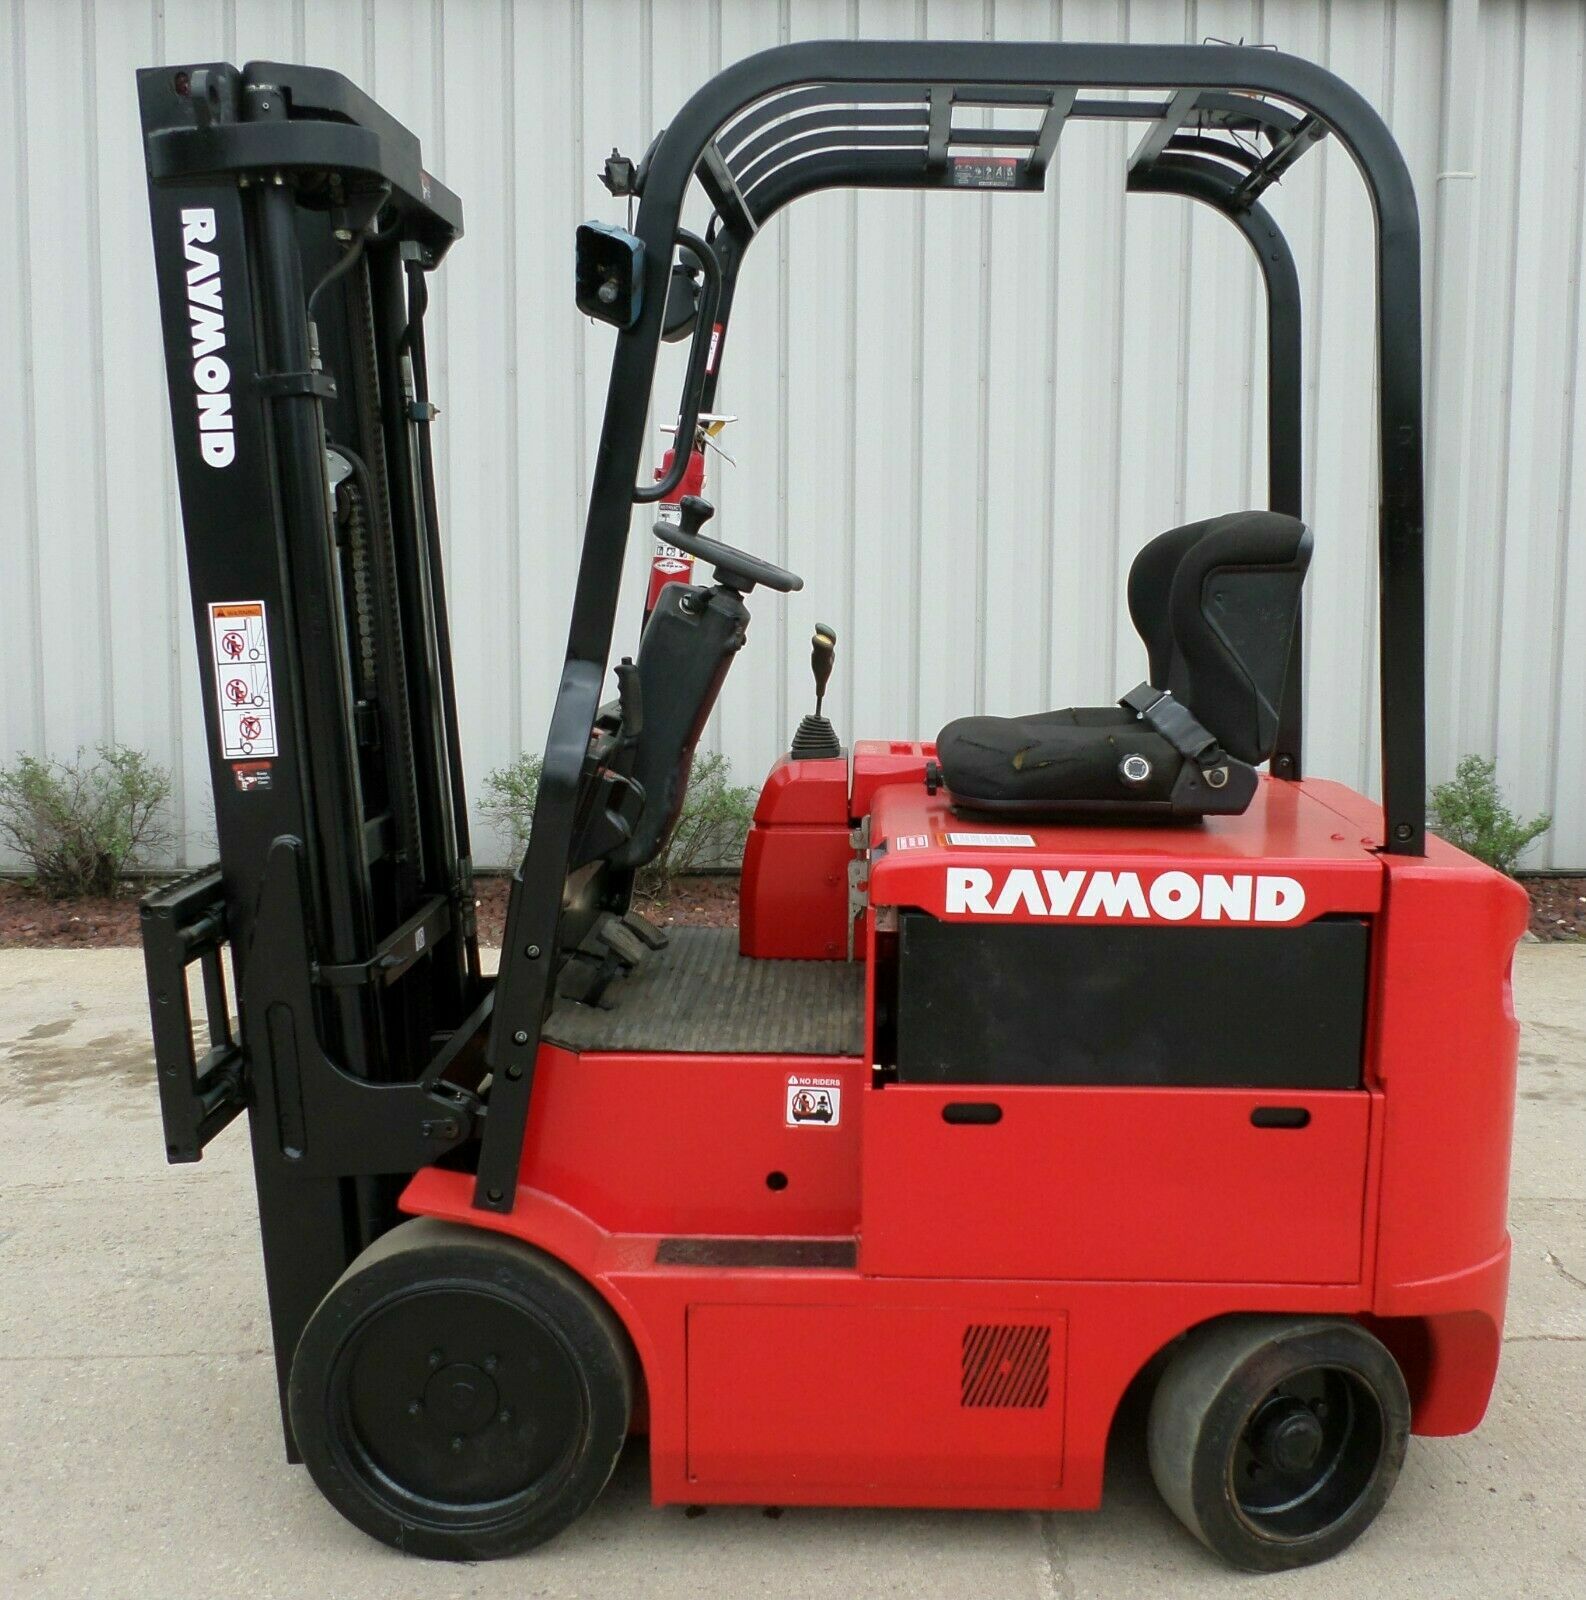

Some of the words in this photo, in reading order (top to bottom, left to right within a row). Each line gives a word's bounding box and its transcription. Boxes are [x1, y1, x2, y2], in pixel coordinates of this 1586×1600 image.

[181, 208, 235, 468] RAYMOND
[945, 867, 1306, 922] RAYMOND
[800, 1077, 811, 1085] NO
[812, 1078, 840, 1086] RIDERS
